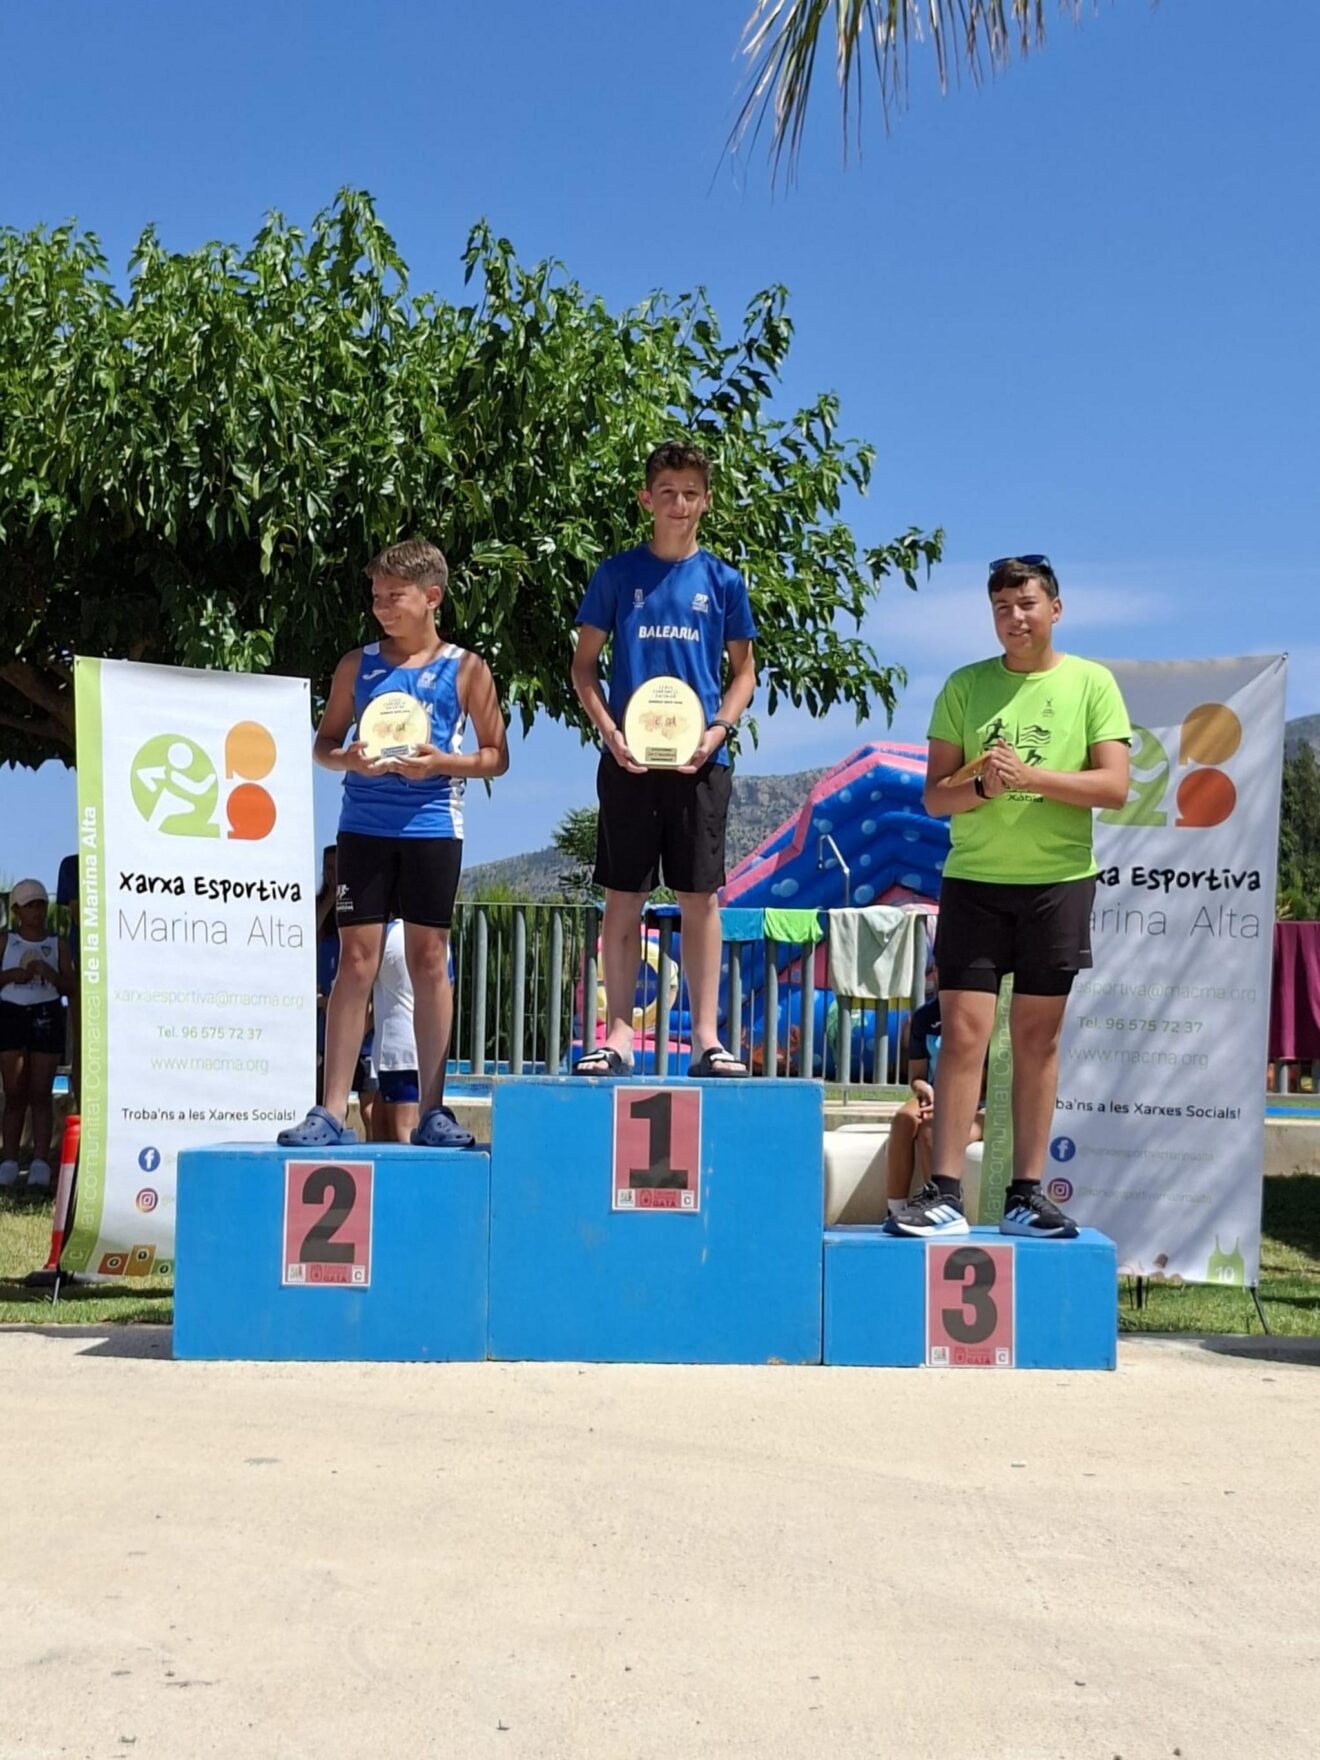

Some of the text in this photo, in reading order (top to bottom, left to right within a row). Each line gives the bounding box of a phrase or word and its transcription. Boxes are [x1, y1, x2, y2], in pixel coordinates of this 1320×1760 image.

[638, 625, 700, 642] BALEARIA
[81, 806, 97, 848] Alta
[83, 854, 98, 927] Marina
[194, 876, 302, 903] Esportiva
[1131, 866, 1261, 893] Esportiva
[118, 908, 304, 948] Marina Alta
[1089, 902, 1260, 938] rina Alta
[84, 932, 99, 951] la
[84, 957, 99, 983] de
[113, 988, 305, 1010] xarxaesportiva@macma.org
[1075, 981, 1257, 1003] esportiva@macma.org
[157, 1025, 263, 1041] Tel. 96 575 72 37
[1105, 1018, 1125, 1030] 96
[1128, 1019, 1157, 1032] 575
[1162, 1020, 1180, 1032] 72
[1184, 1021, 1204, 1033] 37
[84, 991, 100, 1089] Comarcal
[150, 1056, 269, 1075] www.macma.org
[1068, 1046, 1209, 1069] www.macma.org
[122, 1108, 297, 1122] Troba'ns a les Xarxes Socials!
[1055, 1096, 1241, 1120] ba'ns a les Xarxes Socials!
[629, 1092, 688, 1189] 1
[299, 1166, 357, 1264] 2
[942, 1246, 998, 1344] 3
